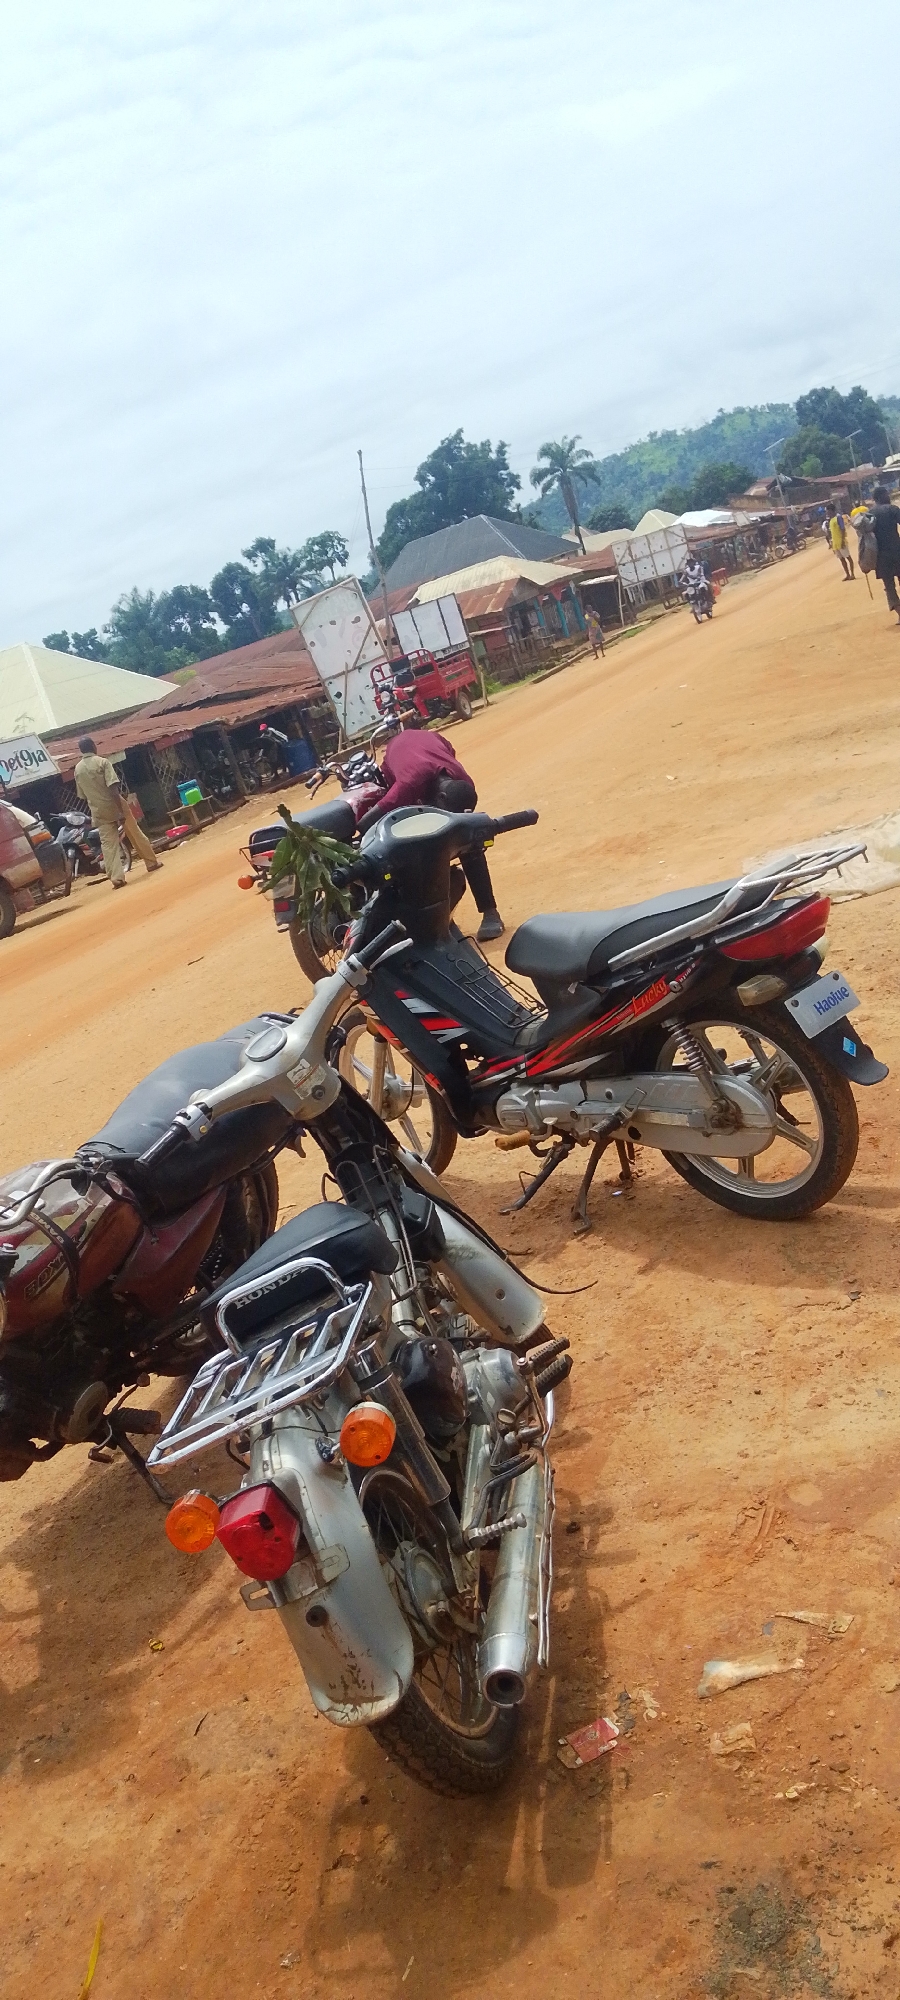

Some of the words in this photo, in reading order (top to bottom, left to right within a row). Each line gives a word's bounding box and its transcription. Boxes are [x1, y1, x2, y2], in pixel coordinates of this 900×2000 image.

[632, 980, 668, 1015] Lucky
[813, 986, 849, 1015] Haojue
[232, 1267, 309, 1309] HONDA
